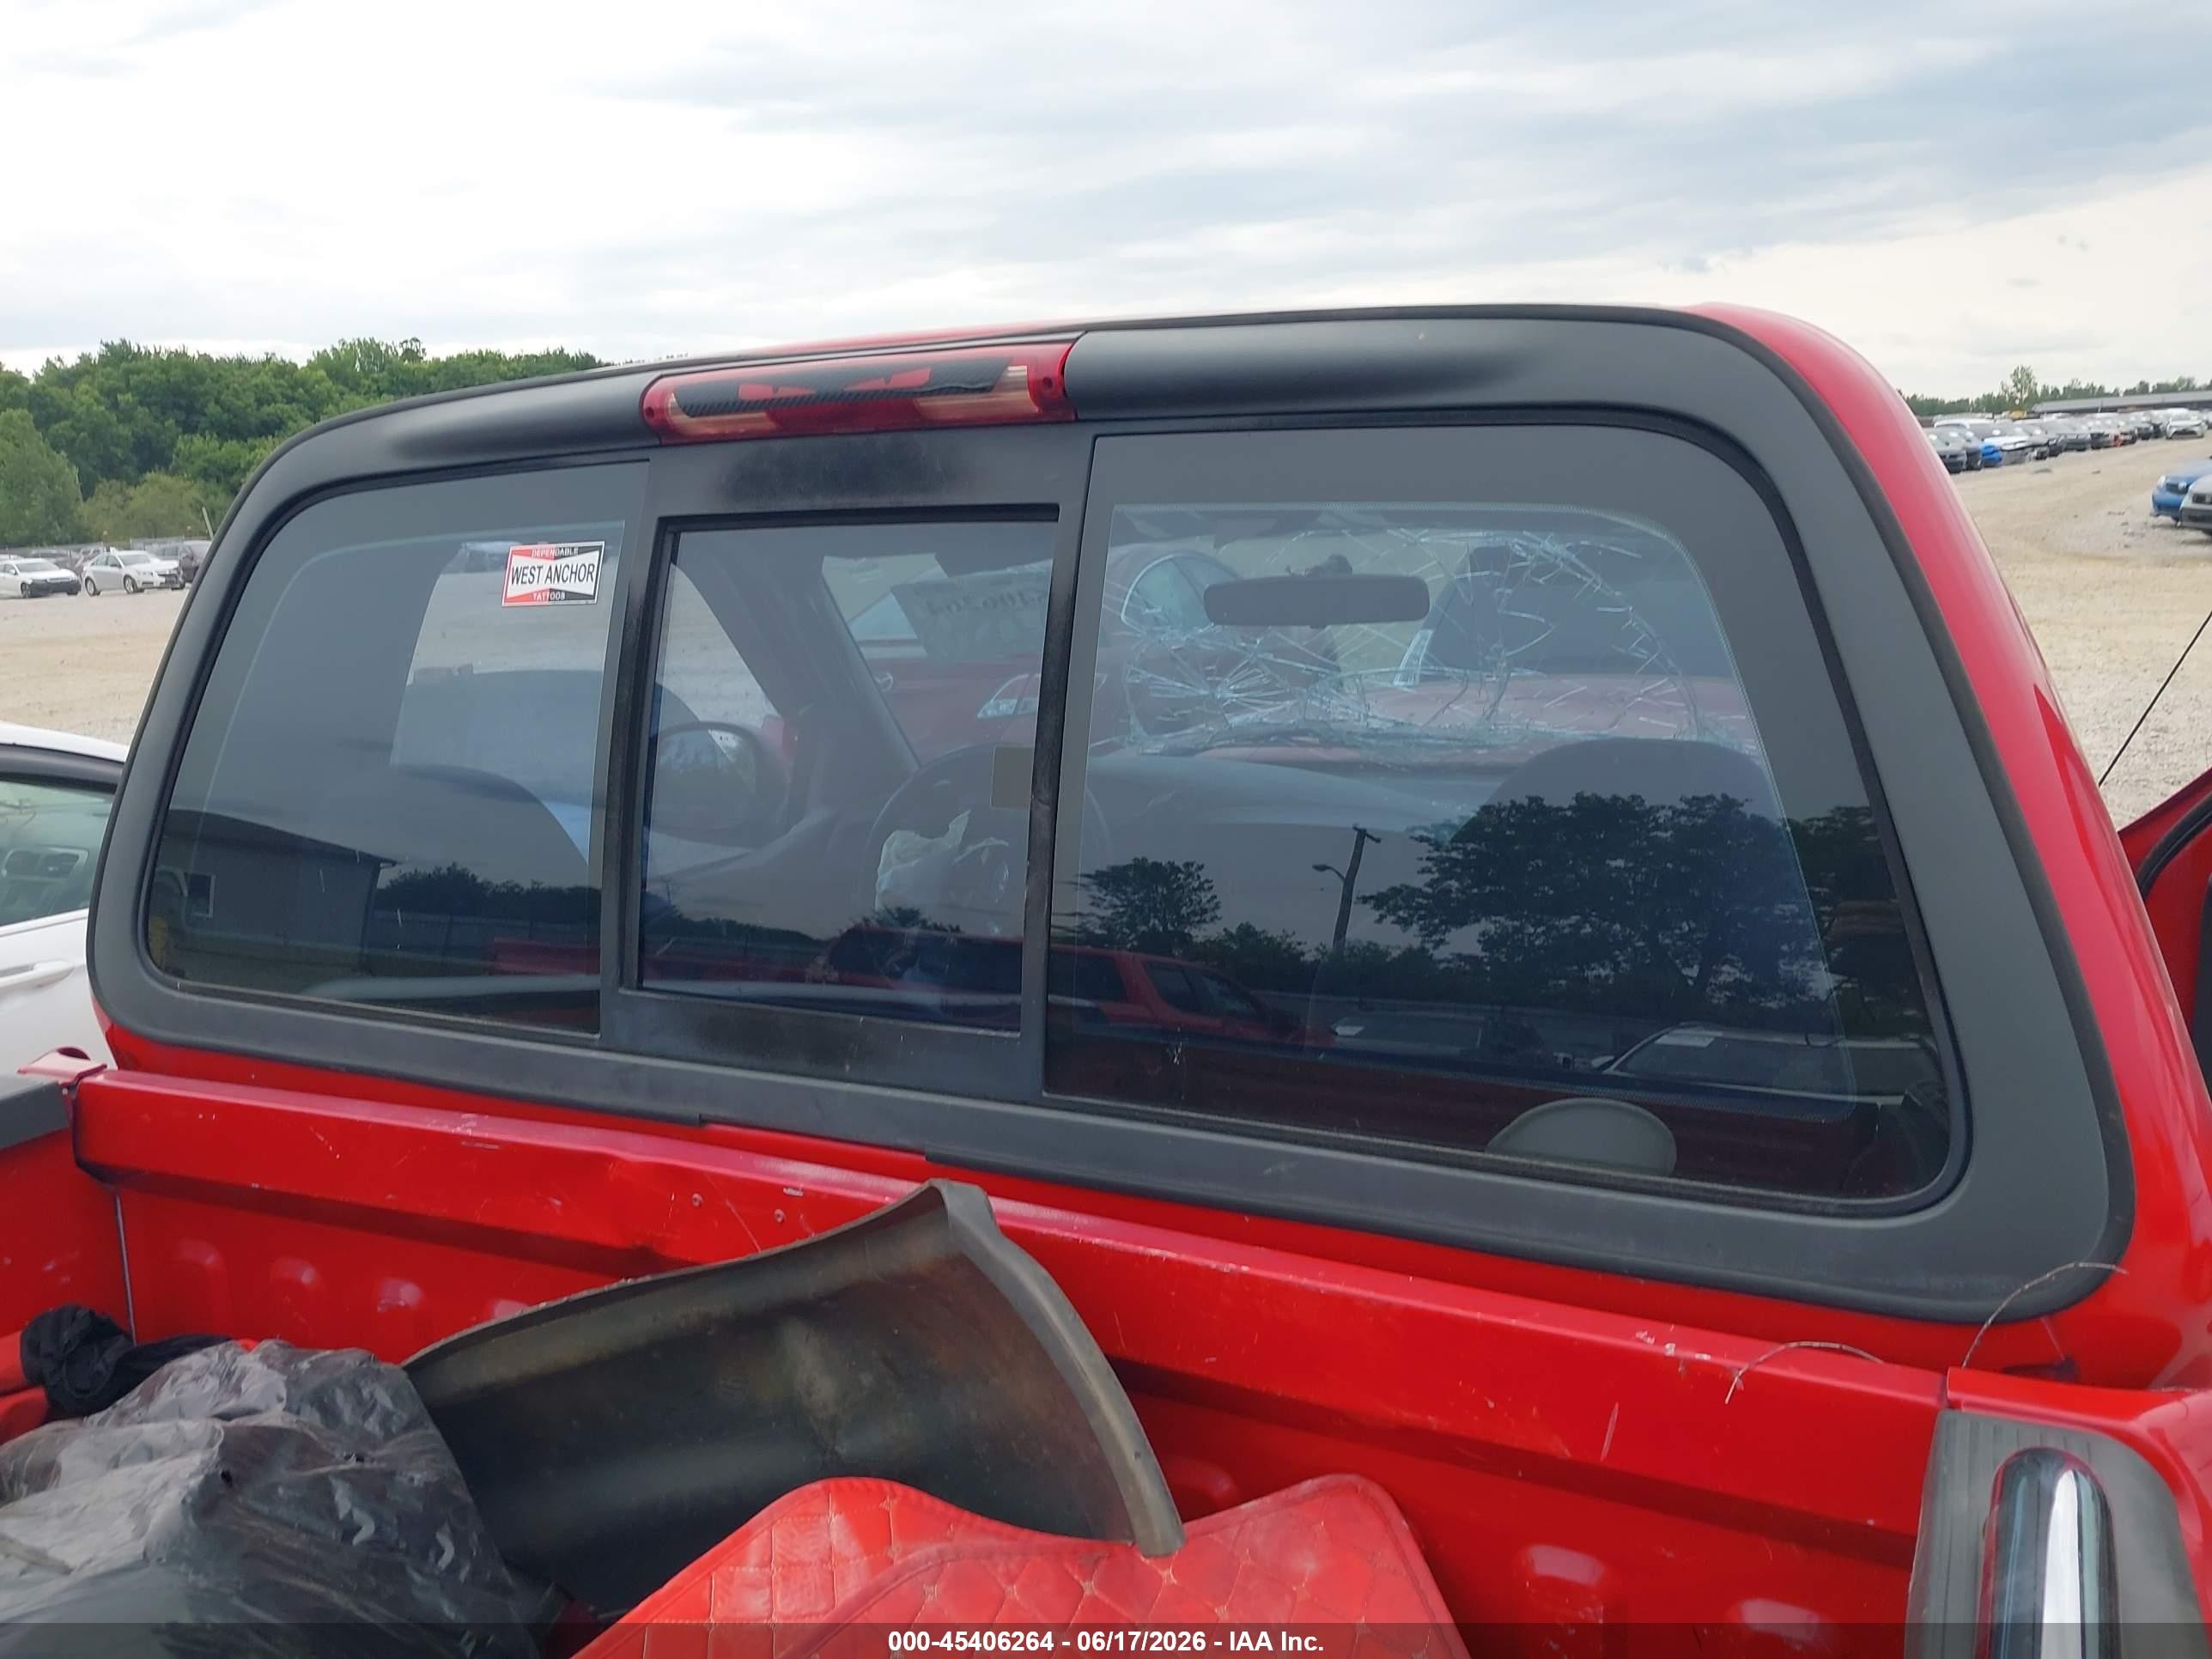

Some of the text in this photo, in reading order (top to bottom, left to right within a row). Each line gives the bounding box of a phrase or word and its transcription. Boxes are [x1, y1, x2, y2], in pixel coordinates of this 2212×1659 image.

[532, 547, 578, 557] DEPENDABLE
[511, 563, 595, 584] WEST ANCHOR
